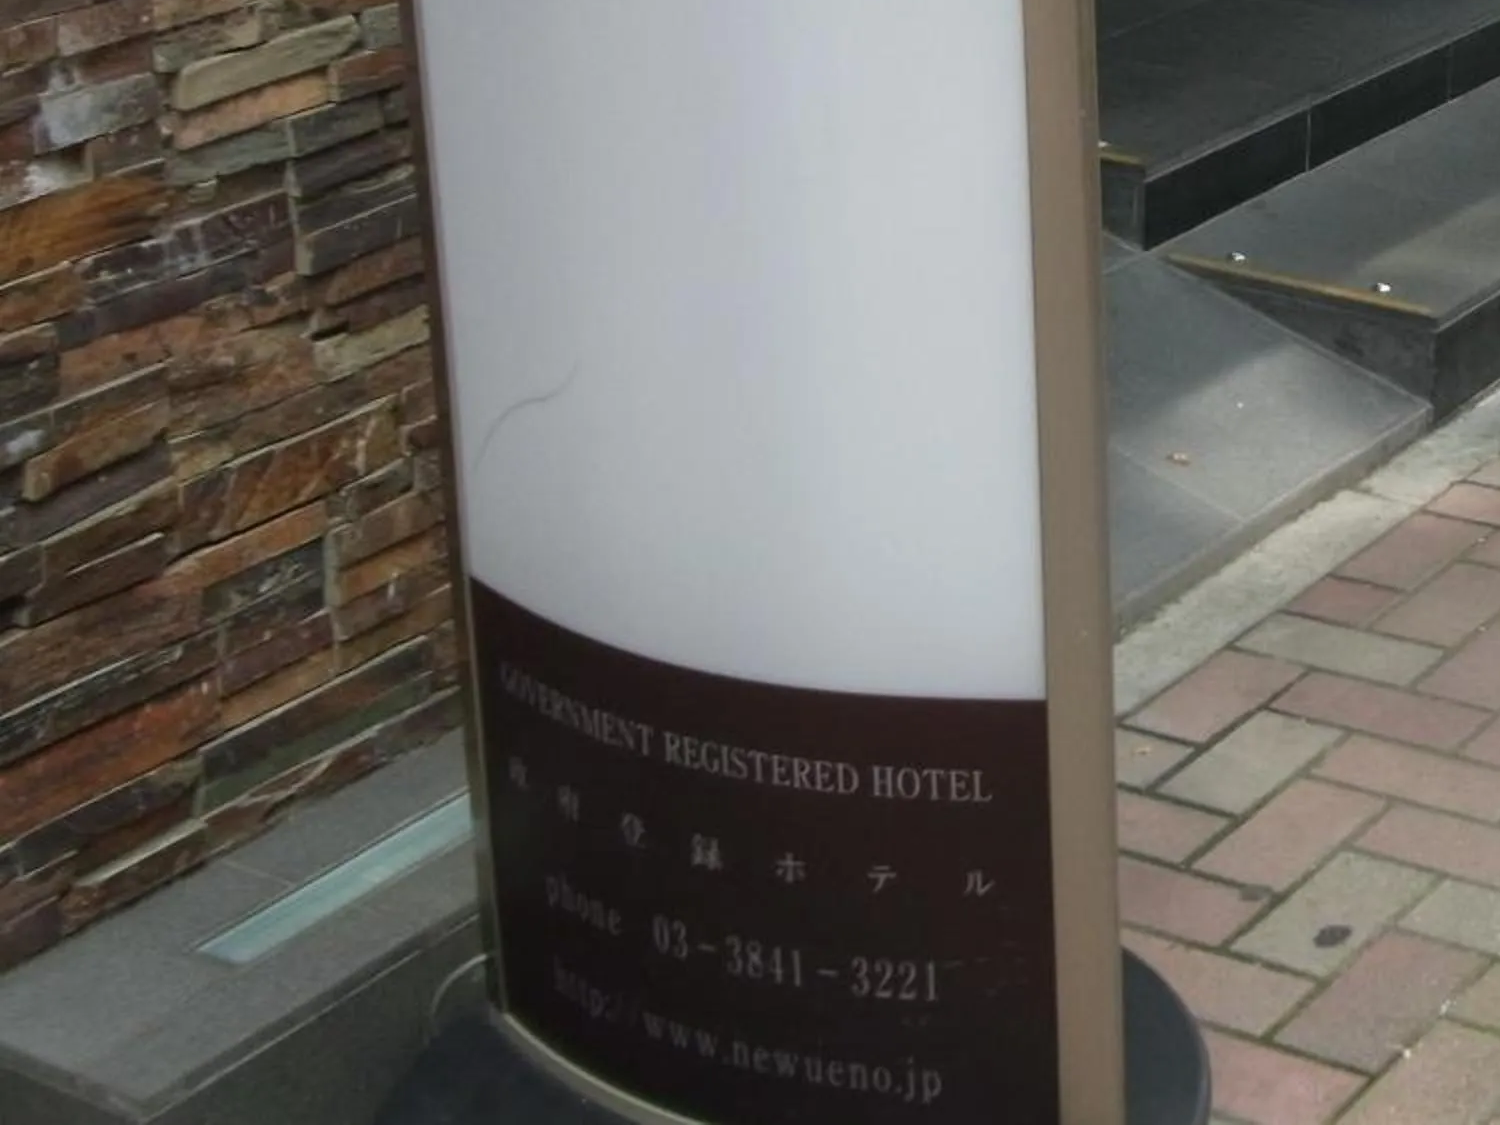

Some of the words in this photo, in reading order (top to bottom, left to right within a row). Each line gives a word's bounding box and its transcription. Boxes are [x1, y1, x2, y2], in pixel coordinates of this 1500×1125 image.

[500, 662, 654, 757] GOVERNMENT
[663, 730, 860, 795] REGISTERED
[872, 765, 993, 803] HOTEL
